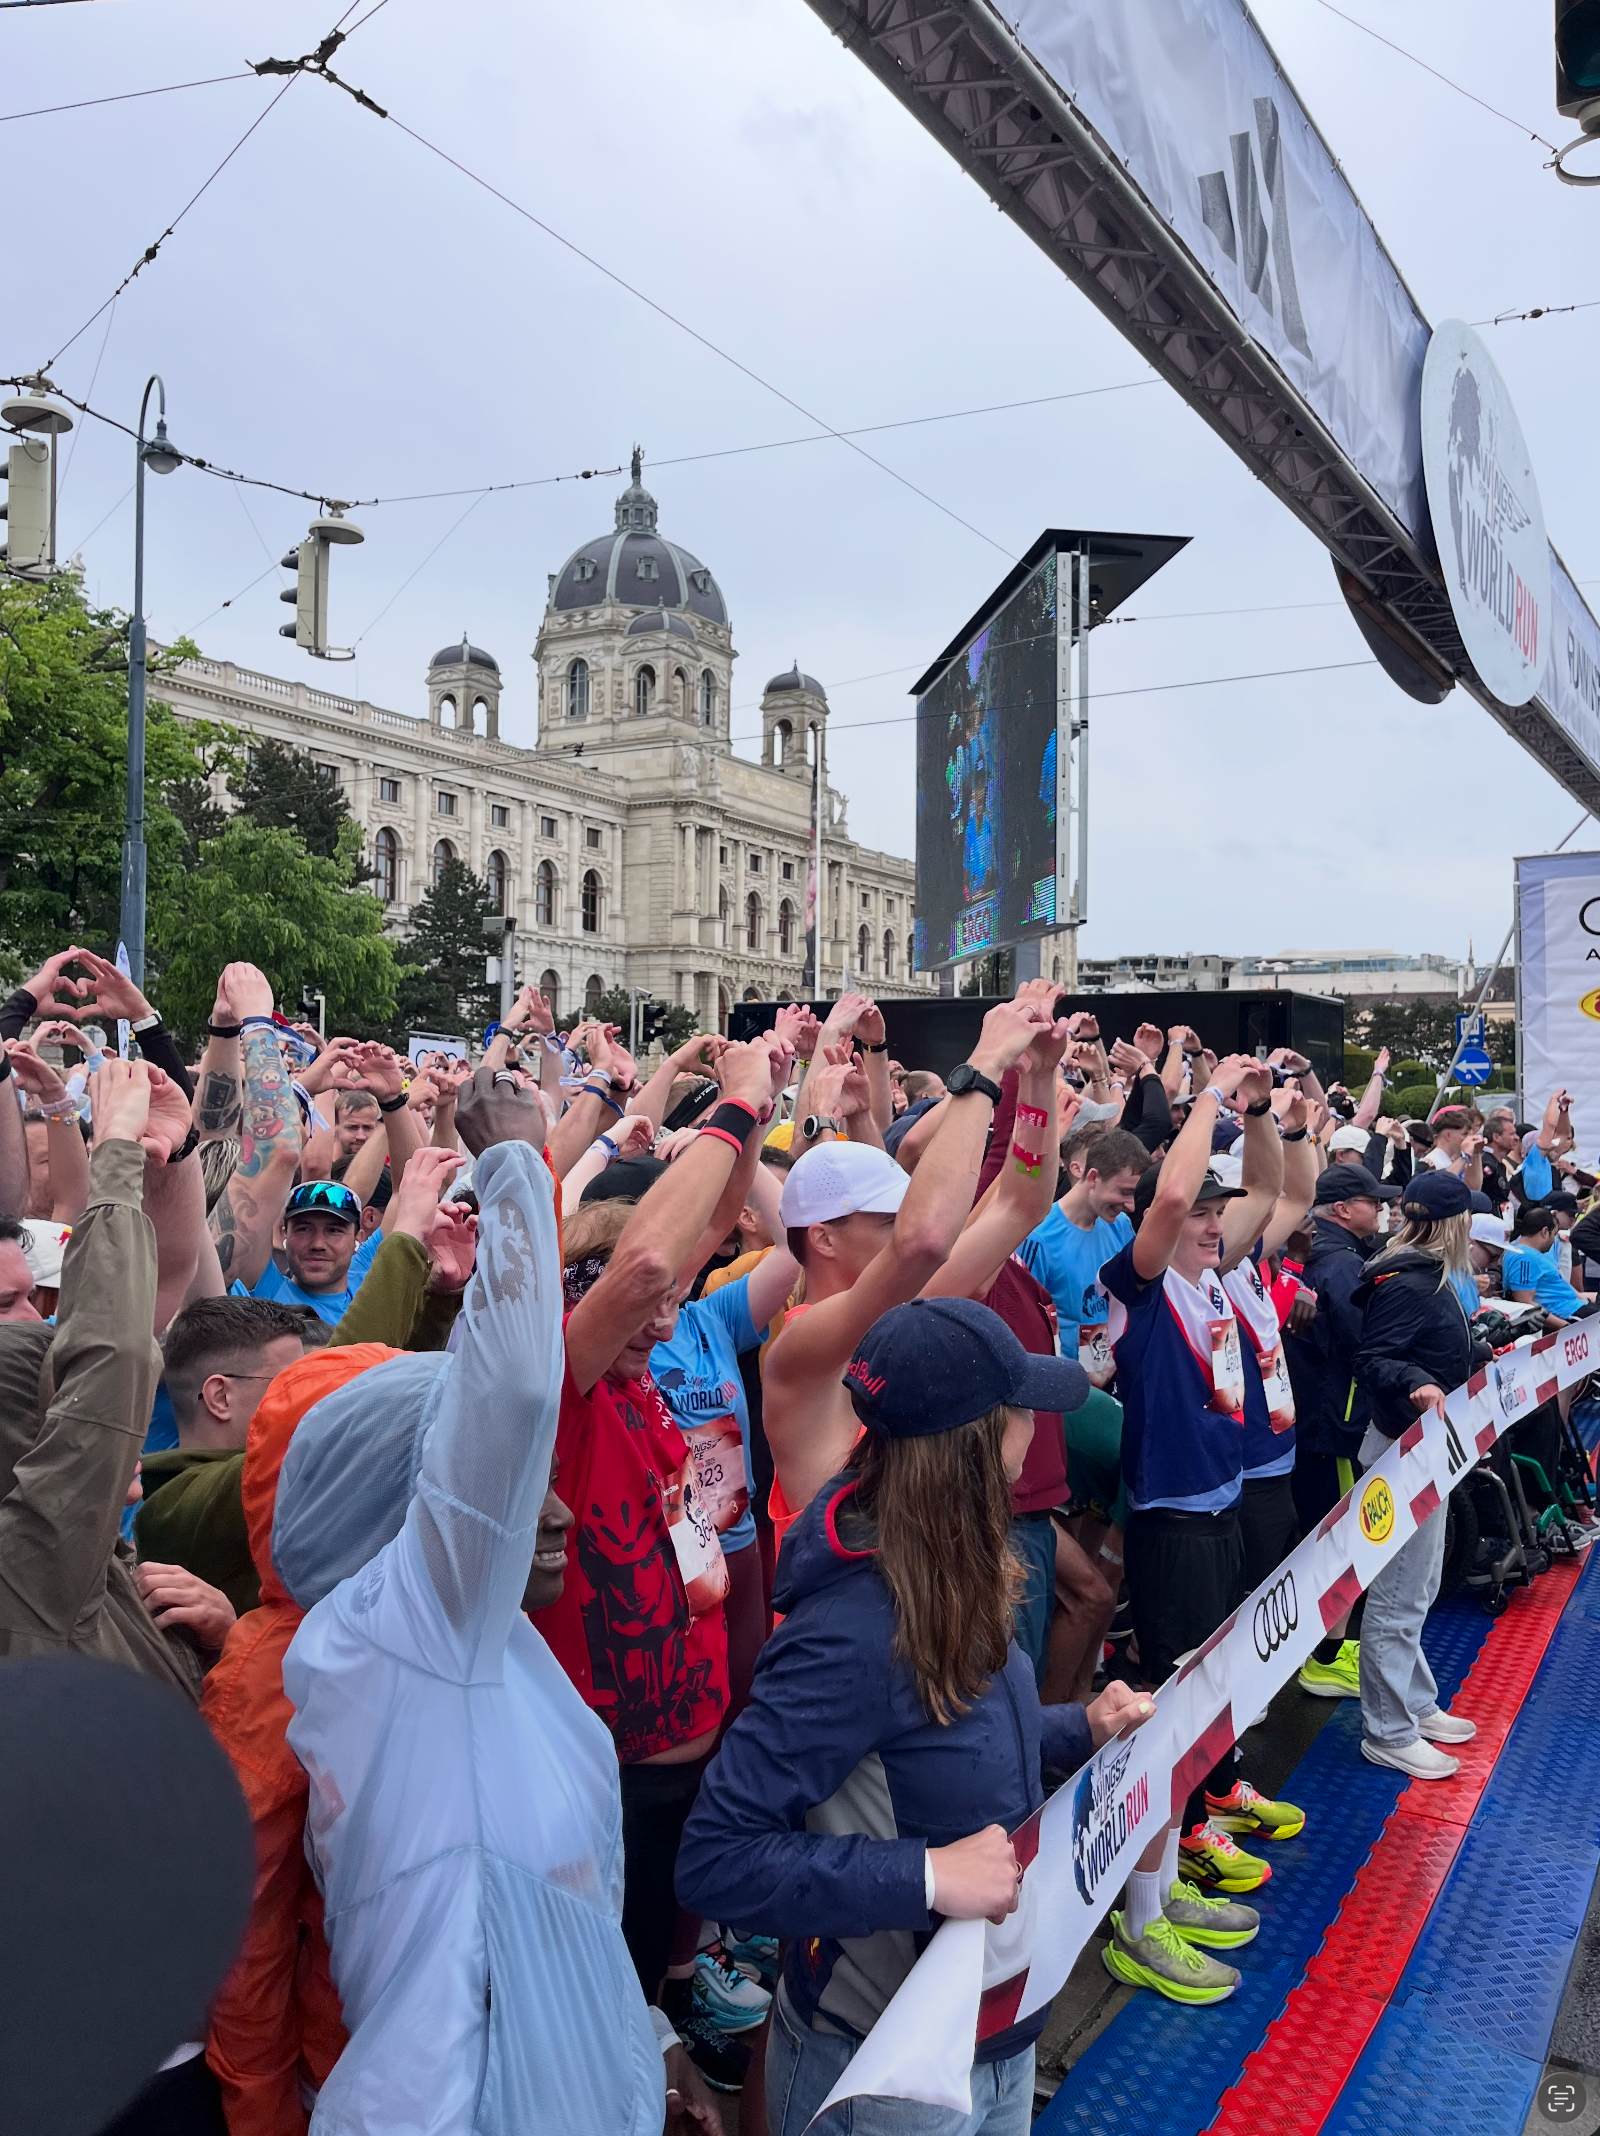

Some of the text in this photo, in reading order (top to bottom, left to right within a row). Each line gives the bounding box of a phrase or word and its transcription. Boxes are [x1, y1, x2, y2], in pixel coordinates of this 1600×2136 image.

[1466, 500, 1538, 668] WORLD RUN
[1564, 1332, 1589, 1367] ERGO
[675, 1387, 723, 1412] WORLD
[1092, 1758, 1121, 1809] WINGS
[1100, 1788, 1115, 1827] LIFE
[1086, 1771, 1149, 1891] WORLD RUN
